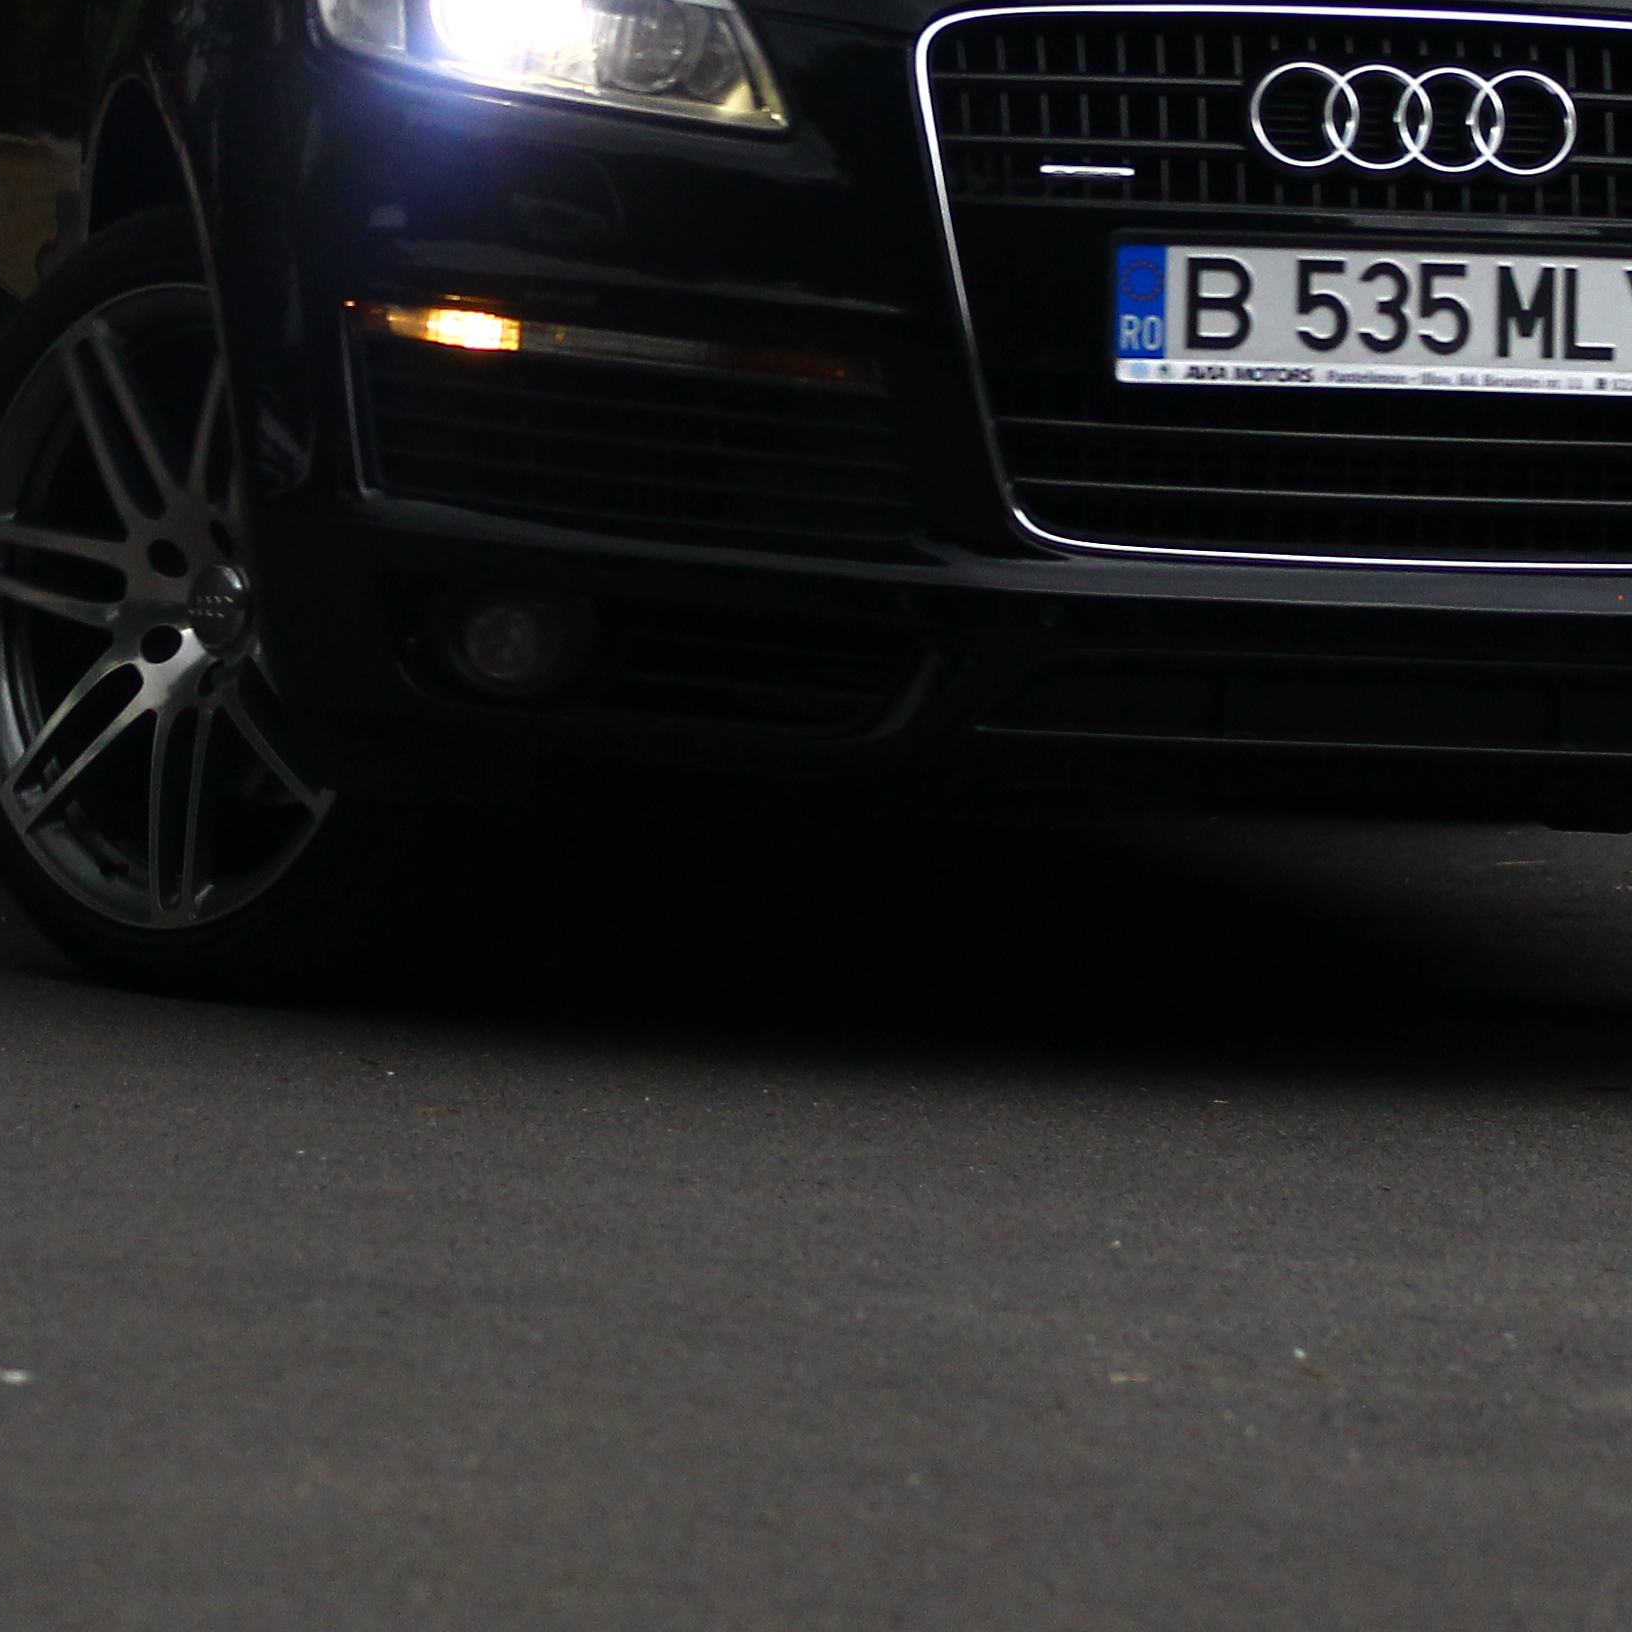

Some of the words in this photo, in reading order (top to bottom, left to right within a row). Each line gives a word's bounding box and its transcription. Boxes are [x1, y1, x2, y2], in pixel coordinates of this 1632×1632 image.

[1186, 256, 1252, 350] B
[1296, 258, 1470, 356] 535
[1120, 314, 1163, 351] RO
[1235, 366, 1315, 383] MOTORS
